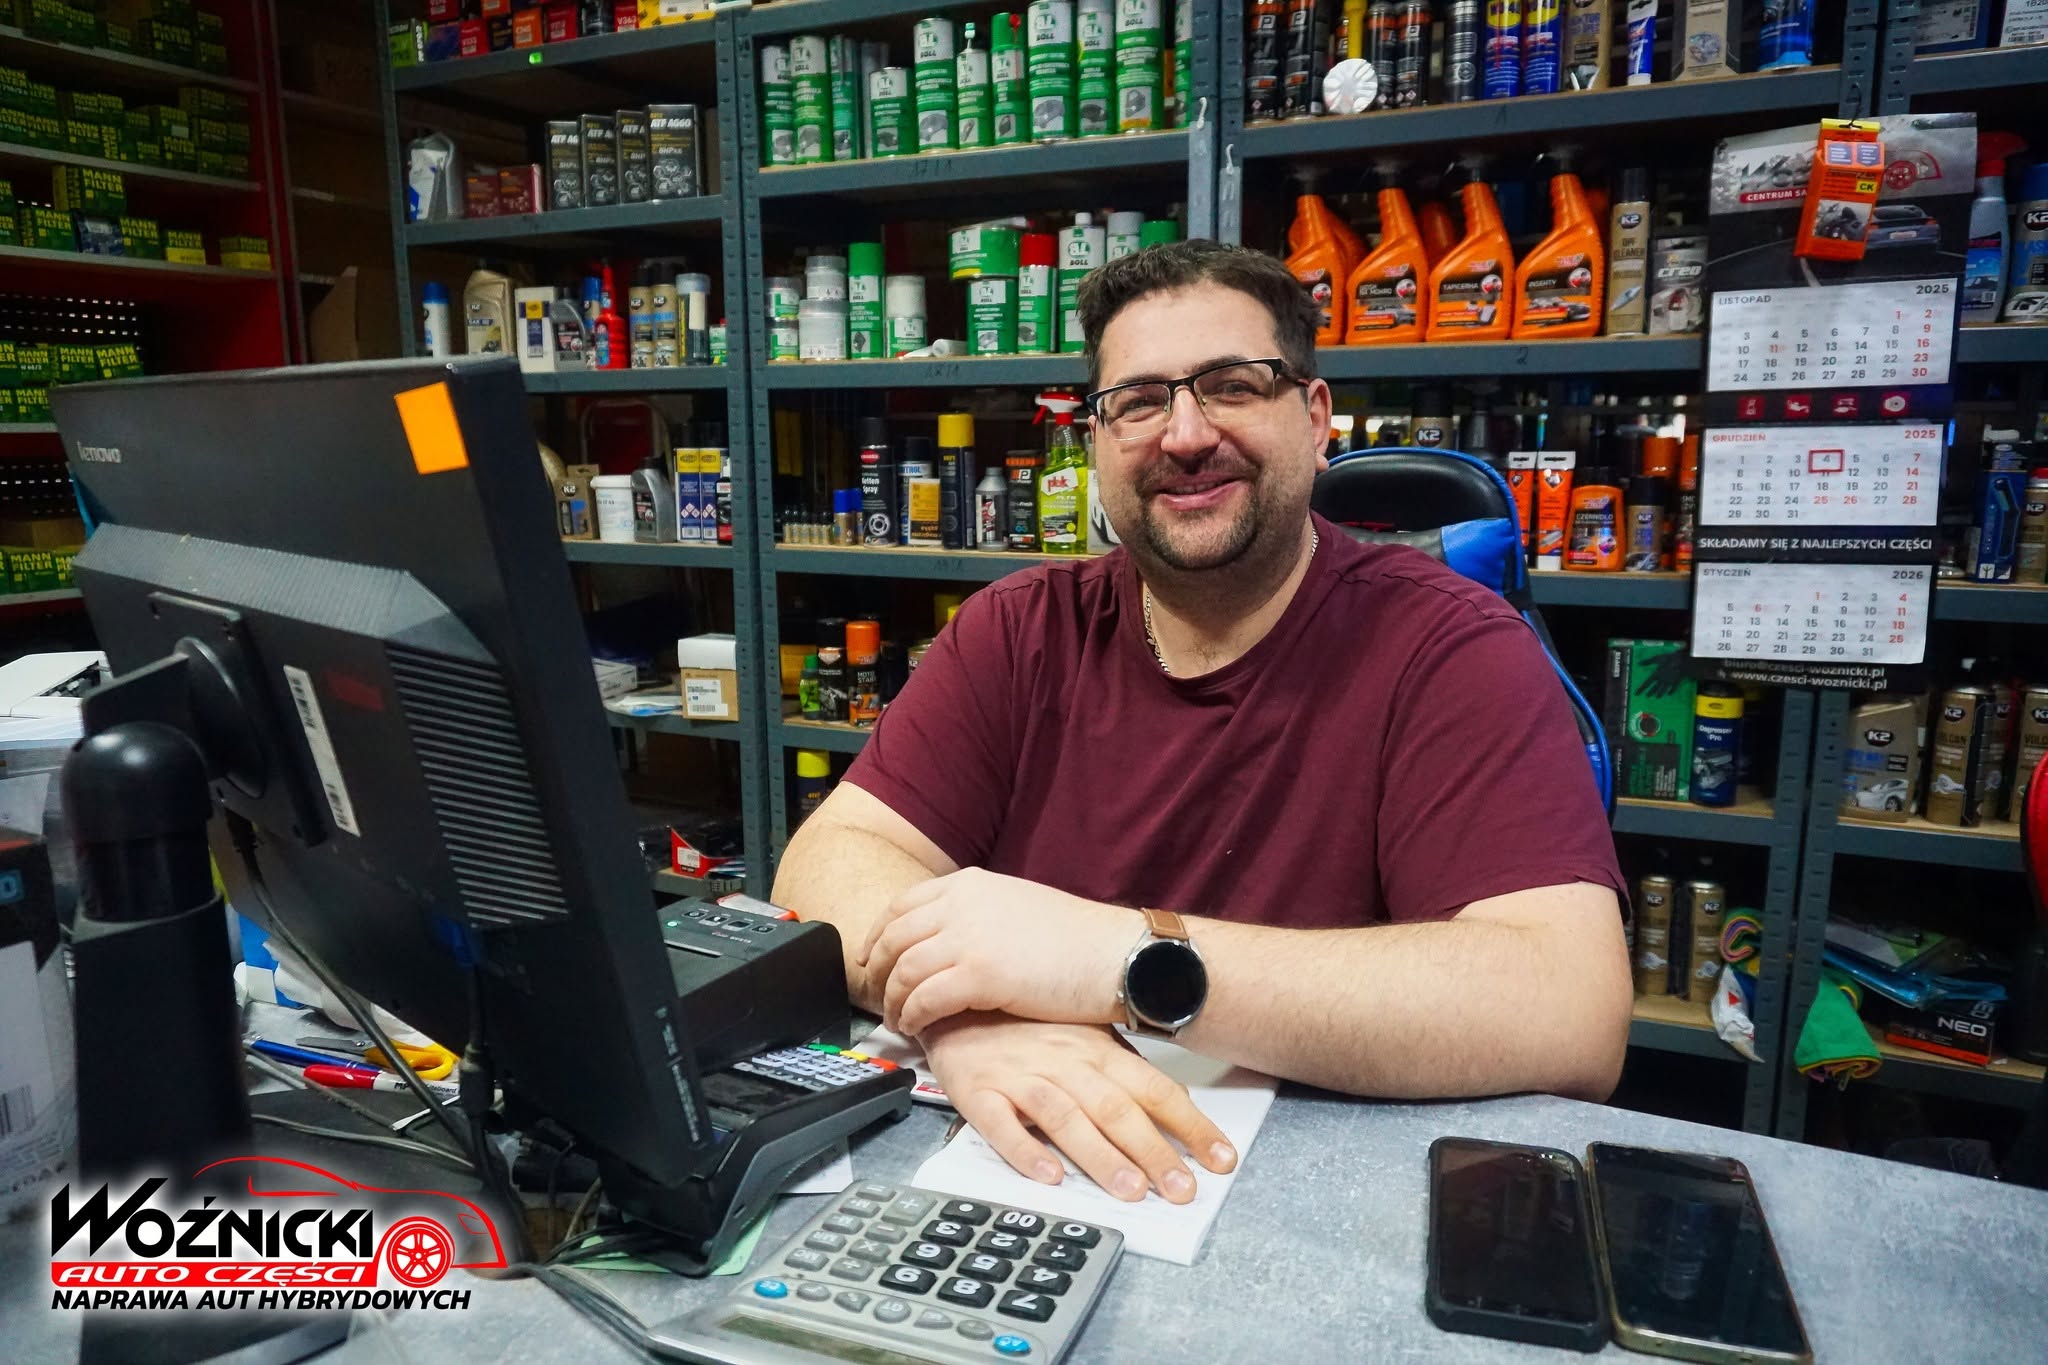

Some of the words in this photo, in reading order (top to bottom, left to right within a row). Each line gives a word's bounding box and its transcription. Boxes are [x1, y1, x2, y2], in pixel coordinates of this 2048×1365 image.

[82, 168, 122, 182] MANN
[84, 178, 124, 192] FILTER
[1860, 184, 1874, 192] CK
[1746, 190, 1792, 201] CENTRUM
[35, 208, 70, 220] MANN
[1622, 214, 1639, 224] K2
[36, 218, 72, 230] FILTER
[120, 217, 158, 230] MANN
[122, 227, 158, 238] FILTER
[168, 231, 202, 240] MANN
[654, 296, 664, 305] K2
[1719, 295, 1772, 305] LISTOPAD
[1916, 284, 1949, 294] 2025
[1925, 309, 1932, 318] 2
[1801, 329, 1808, 338] 5
[1831, 328, 1838, 336] 6
[1863, 327, 1869, 335] 7
[1892, 325, 1900, 334] 8
[1923, 324, 1931, 333] 9
[96, 346, 134, 358] MANN
[1738, 346, 1749, 354] 10
[1770, 345, 1778, 353] 11
[1796, 344, 1808, 352] 12
[1826, 342, 1838, 351] 13
[1855, 341, 1867, 350] 14
[1886, 340, 1898, 348] 15
[1917, 339, 1930, 348] 16
[60, 355, 94, 363] FILTER
[100, 355, 137, 367] FILTER
[1739, 360, 1749, 368] 17
[1766, 359, 1777, 367] 18
[1795, 358, 1807, 366] 19
[1822, 357, 1836, 365] 20
[1856, 356, 1867, 364] 21
[1883, 354, 1898, 363] 22
[1914, 353, 1928, 362] 23
[1733, 374, 1748, 382] 24
[1762, 372, 1777, 381] 25
[1792, 372, 1806, 380] 26
[1822, 371, 1836, 380] 27
[1851, 370, 1865, 378] 28
[1882, 369, 1896, 378] 29
[1912, 368, 1928, 377] 30
[1418, 429, 1440, 442] K2
[1712, 432, 1766, 442] GRUDZIEŃ
[1904, 430, 1936, 439] 2025
[1767, 456, 1773, 464] 2
[1795, 455, 1801, 463] 3
[1848, 468, 1859, 477] 12
[1877, 468, 1888, 476] 13
[1906, 468, 1919, 476] 14
[1732, 483, 1743, 491] 15
[1760, 482, 1771, 491] 16
[1790, 482, 1800, 491] 17
[1817, 482, 1829, 490] 18
[1847, 482, 1858, 490] 19
[1873, 482, 1888, 490] 20
[1906, 482, 1918, 490] 21
[1729, 496, 1742, 505] 22
[1757, 496, 1770, 504] 23
[1784, 496, 1799, 504] 24
[1814, 496, 1828, 504] 25
[1843, 496, 1858, 504] 26
[1874, 496, 1888, 504] 27
[1902, 496, 1917, 504] 28
[1728, 510, 1741, 518] 29
[1756, 510, 1770, 518] 30
[1787, 510, 1798, 518] 31
[2027, 504, 2044, 512] K2
[1700, 538, 1767, 548] SKŁADAMY
[1770, 538, 1788, 550] SIĘ
[1791, 539, 1799, 548] Z
[1802, 538, 1886, 550] NAJLEPSZYCH
[1890, 538, 1932, 551] CZĘŚCI
[10, 553, 52, 563] MANN
[12, 561, 52, 570] FILTER
[1704, 568, 1751, 576] STYCZEŃ
[1892, 570, 1924, 580] 2026
[1865, 606, 1877, 615] 10
[1898, 608, 1906, 616] 11
[1722, 616, 1733, 624] 12
[1750, 617, 1760, 626] 13
[1778, 618, 1789, 626] 14
[1806, 619, 1818, 627] 15
[1834, 620, 1846, 628] 16
[1865, 620, 1876, 629] 17
[1893, 621, 1905, 630] 18
[1777, 631, 1788, 640] 21
[1803, 632, 1817, 641] 22
[1832, 633, 1845, 642] 23
[1860, 634, 1874, 642] 24
[1889, 634, 1904, 643] 25
[1717, 643, 1731, 651] 26
[1746, 644, 1760, 652] 27
[1773, 645, 1787, 653] 28
[1802, 646, 1816, 654] 29
[1830, 647, 1845, 655] 30
[1862, 648, 1873, 656] 31
[1732, 670, 1887, 691] www.czesci-woznicki.pl
[1944, 708, 1962, 716] K2
[1868, 730, 1891, 740] K2
[1647, 895, 1662, 904] K2
[1704, 902, 1720, 911] K2
[1938, 1016, 1987, 1037] NEO
[1002, 1212, 1036, 1228] 00
[1062, 1224, 1088, 1237] 0
[935, 1222, 961, 1235] 3
[991, 1232, 1018, 1247] 2
[915, 1242, 941, 1258] 6
[971, 1255, 998, 1270] 5
[1033, 1267, 1058, 1282] 4
[953, 1280, 981, 1295] 8
[1012, 1294, 1039, 1310] 7
